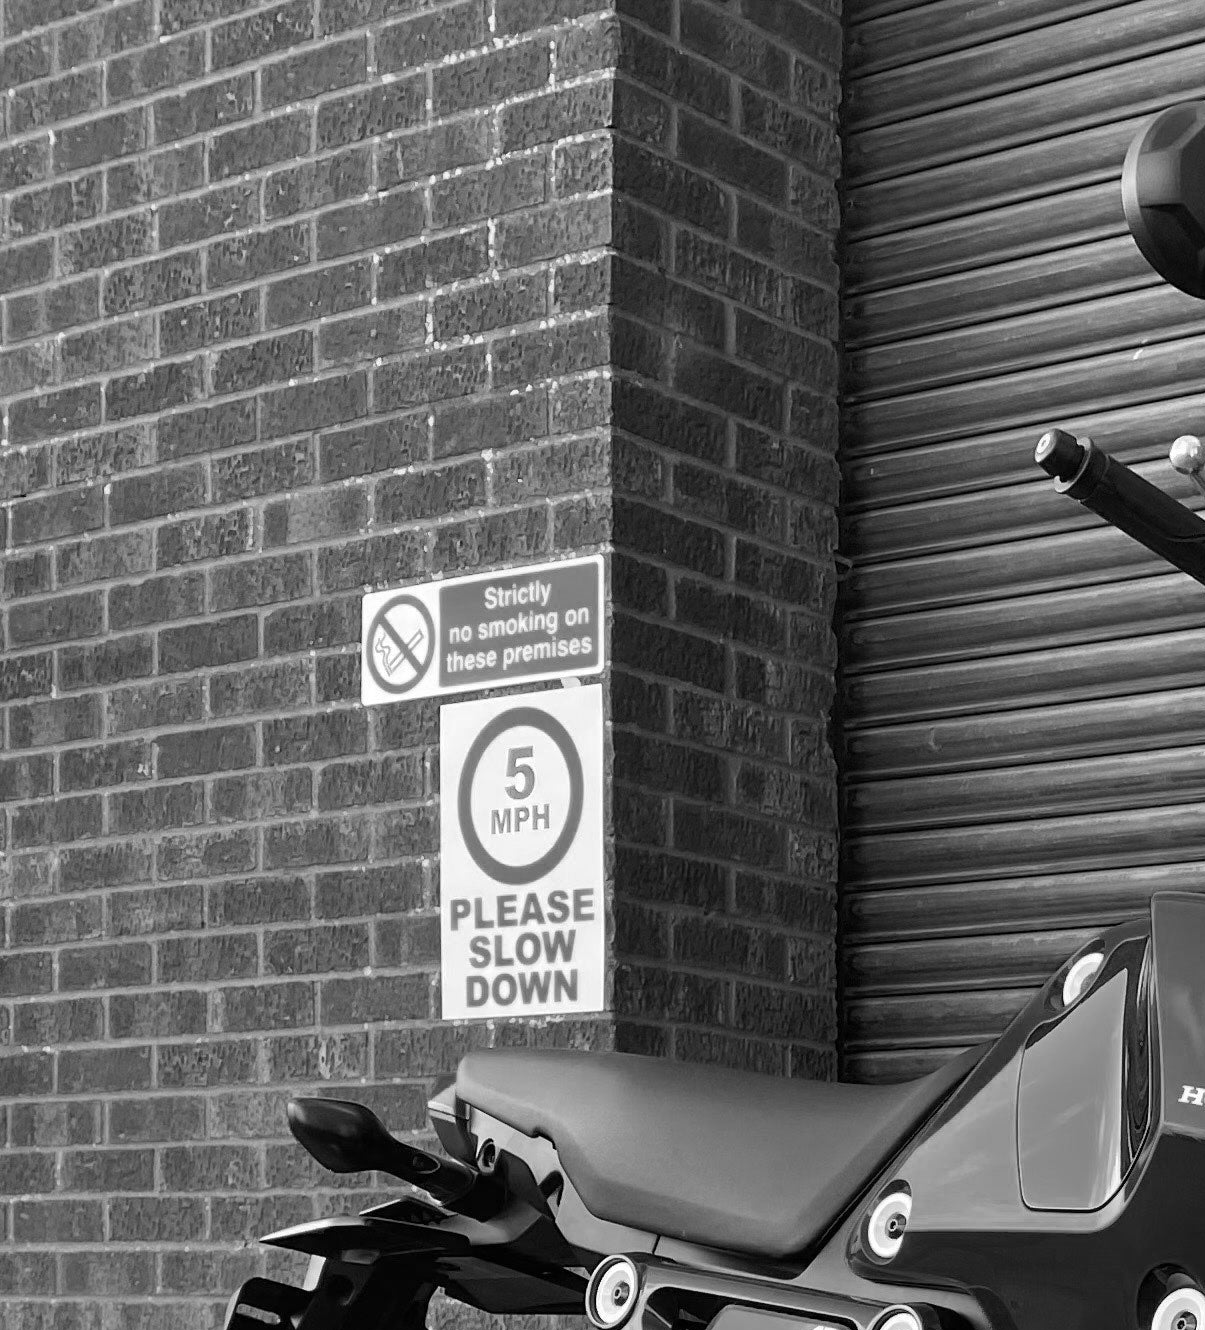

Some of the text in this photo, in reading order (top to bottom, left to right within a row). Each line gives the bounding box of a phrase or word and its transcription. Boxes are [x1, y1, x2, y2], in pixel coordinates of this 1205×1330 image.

[484, 580, 552, 610] Strictly
[448, 606, 590, 644] no smoking on
[445, 634, 593, 674] these premises
[503, 745, 536, 801] 5
[490, 803, 551, 836] MPH
[450, 888, 595, 931] PLEASE
[468, 929, 577, 970] SLOW
[466, 969, 579, 1008] DOWN
